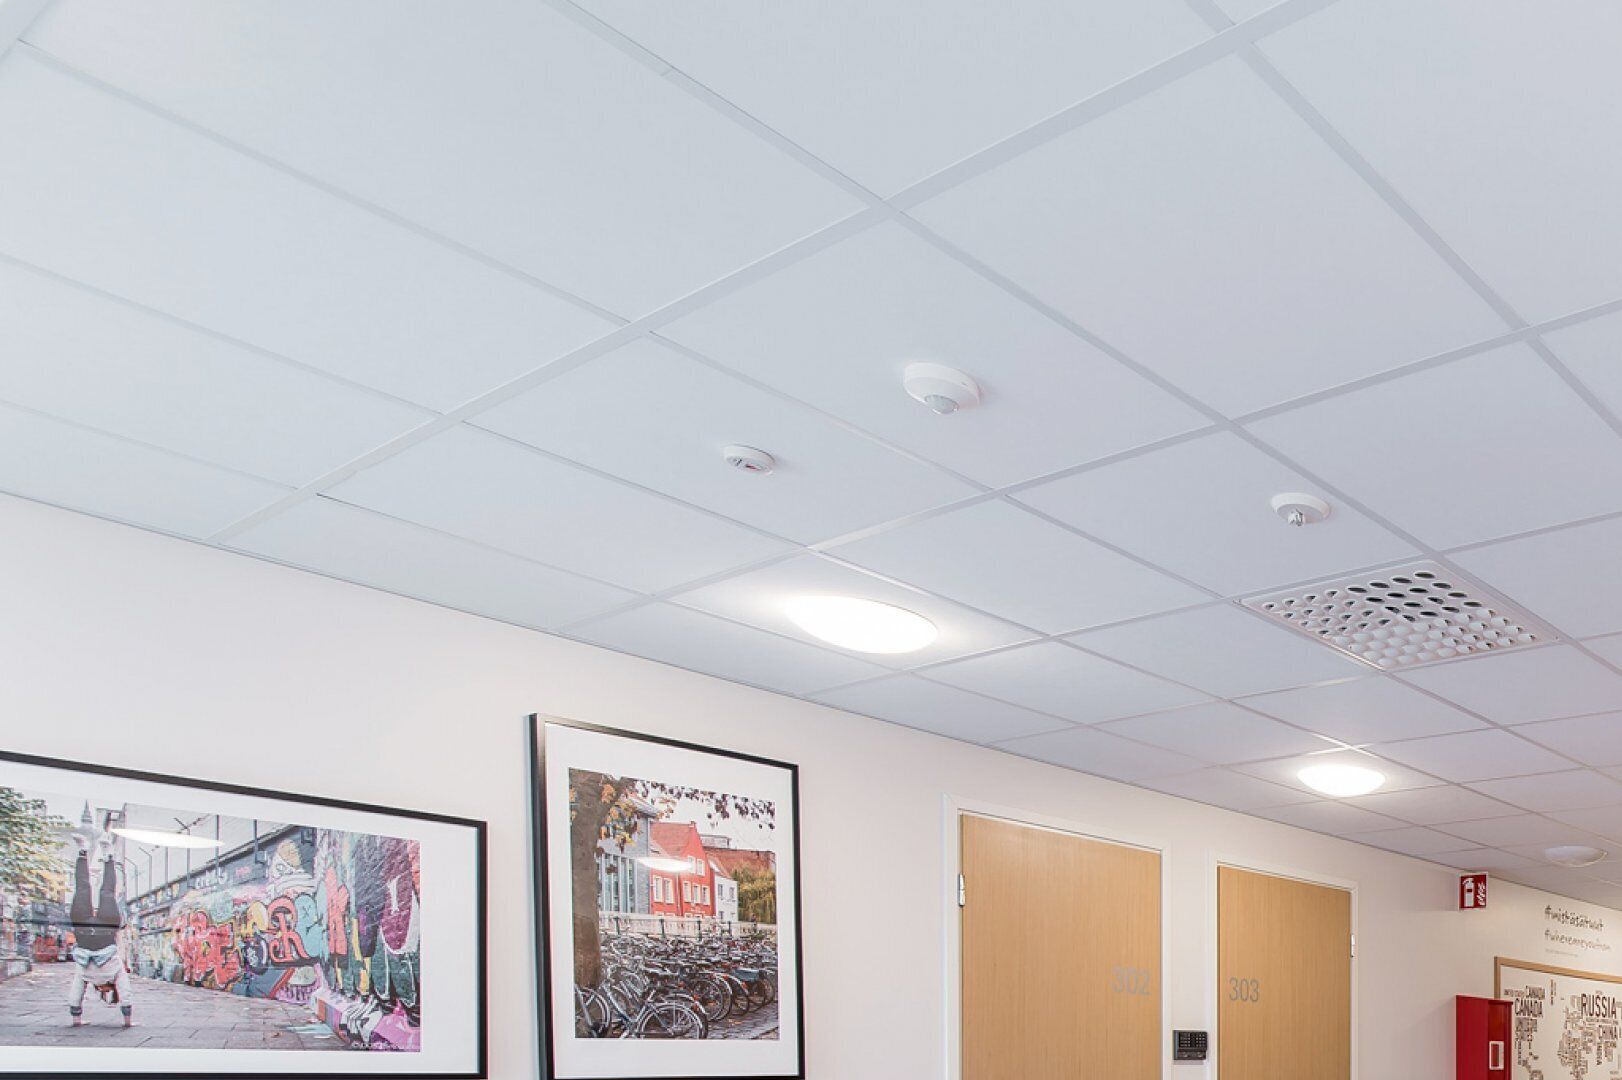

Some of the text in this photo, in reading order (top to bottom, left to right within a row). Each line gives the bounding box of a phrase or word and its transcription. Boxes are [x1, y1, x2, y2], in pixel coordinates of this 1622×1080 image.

[1229, 977, 1260, 1002] 303
[1515, 998, 1543, 1018] CANADA
[1581, 993, 1617, 1019] RUSSIA
